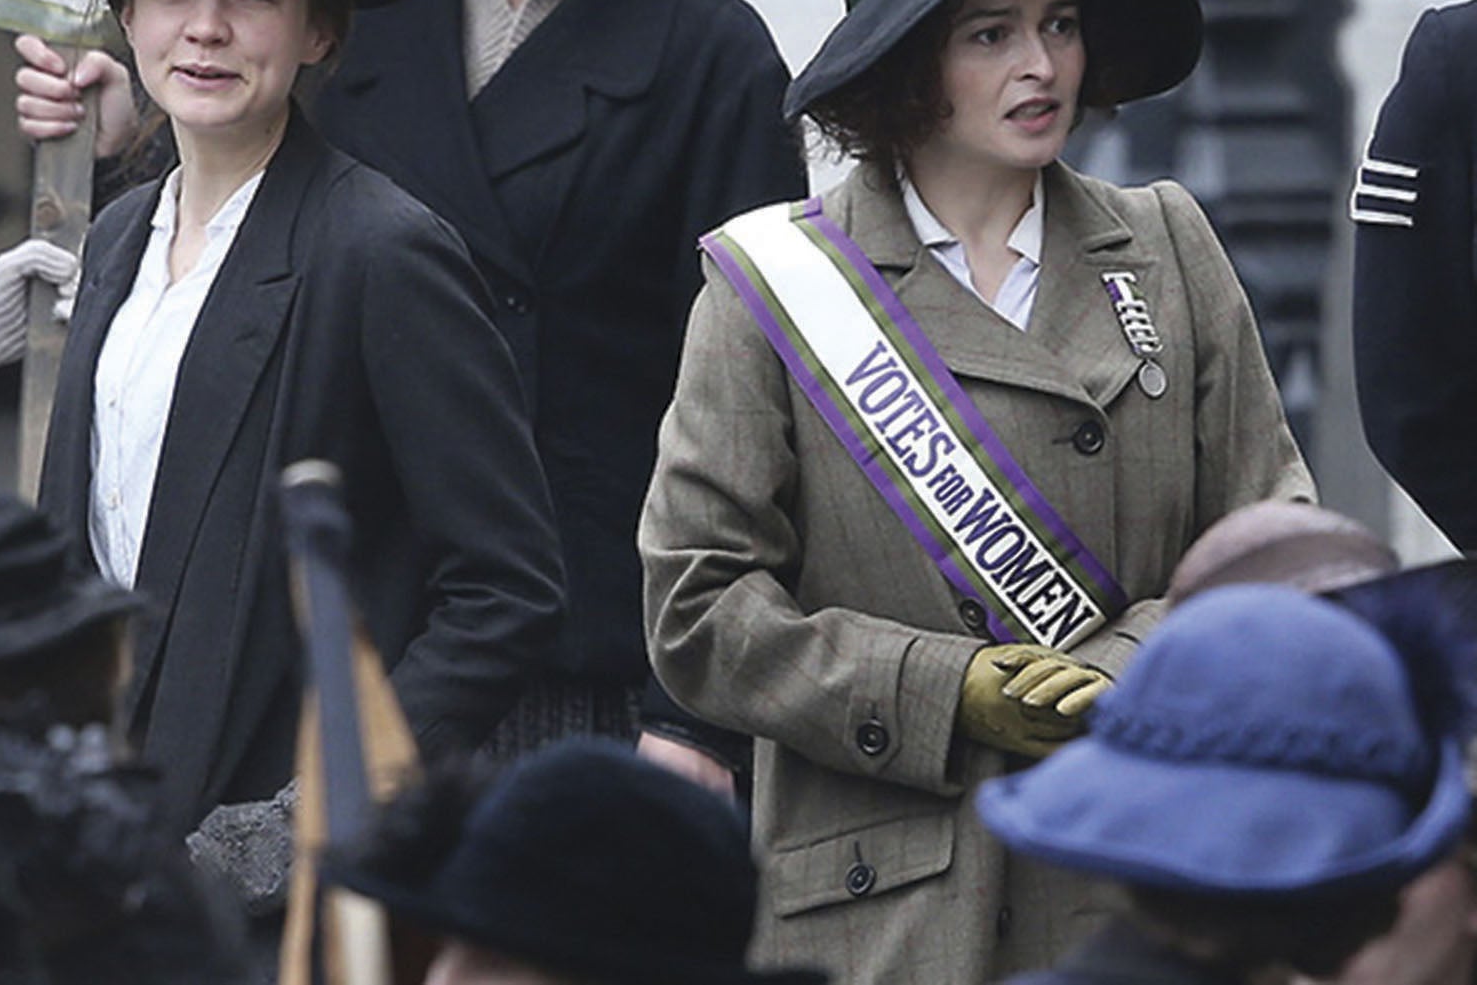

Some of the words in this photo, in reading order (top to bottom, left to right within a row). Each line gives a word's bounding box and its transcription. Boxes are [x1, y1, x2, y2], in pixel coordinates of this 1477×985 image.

[843, 341, 955, 478] VOTES
[926, 463, 974, 517] FOR
[953, 487, 1094, 650] WOMEN
